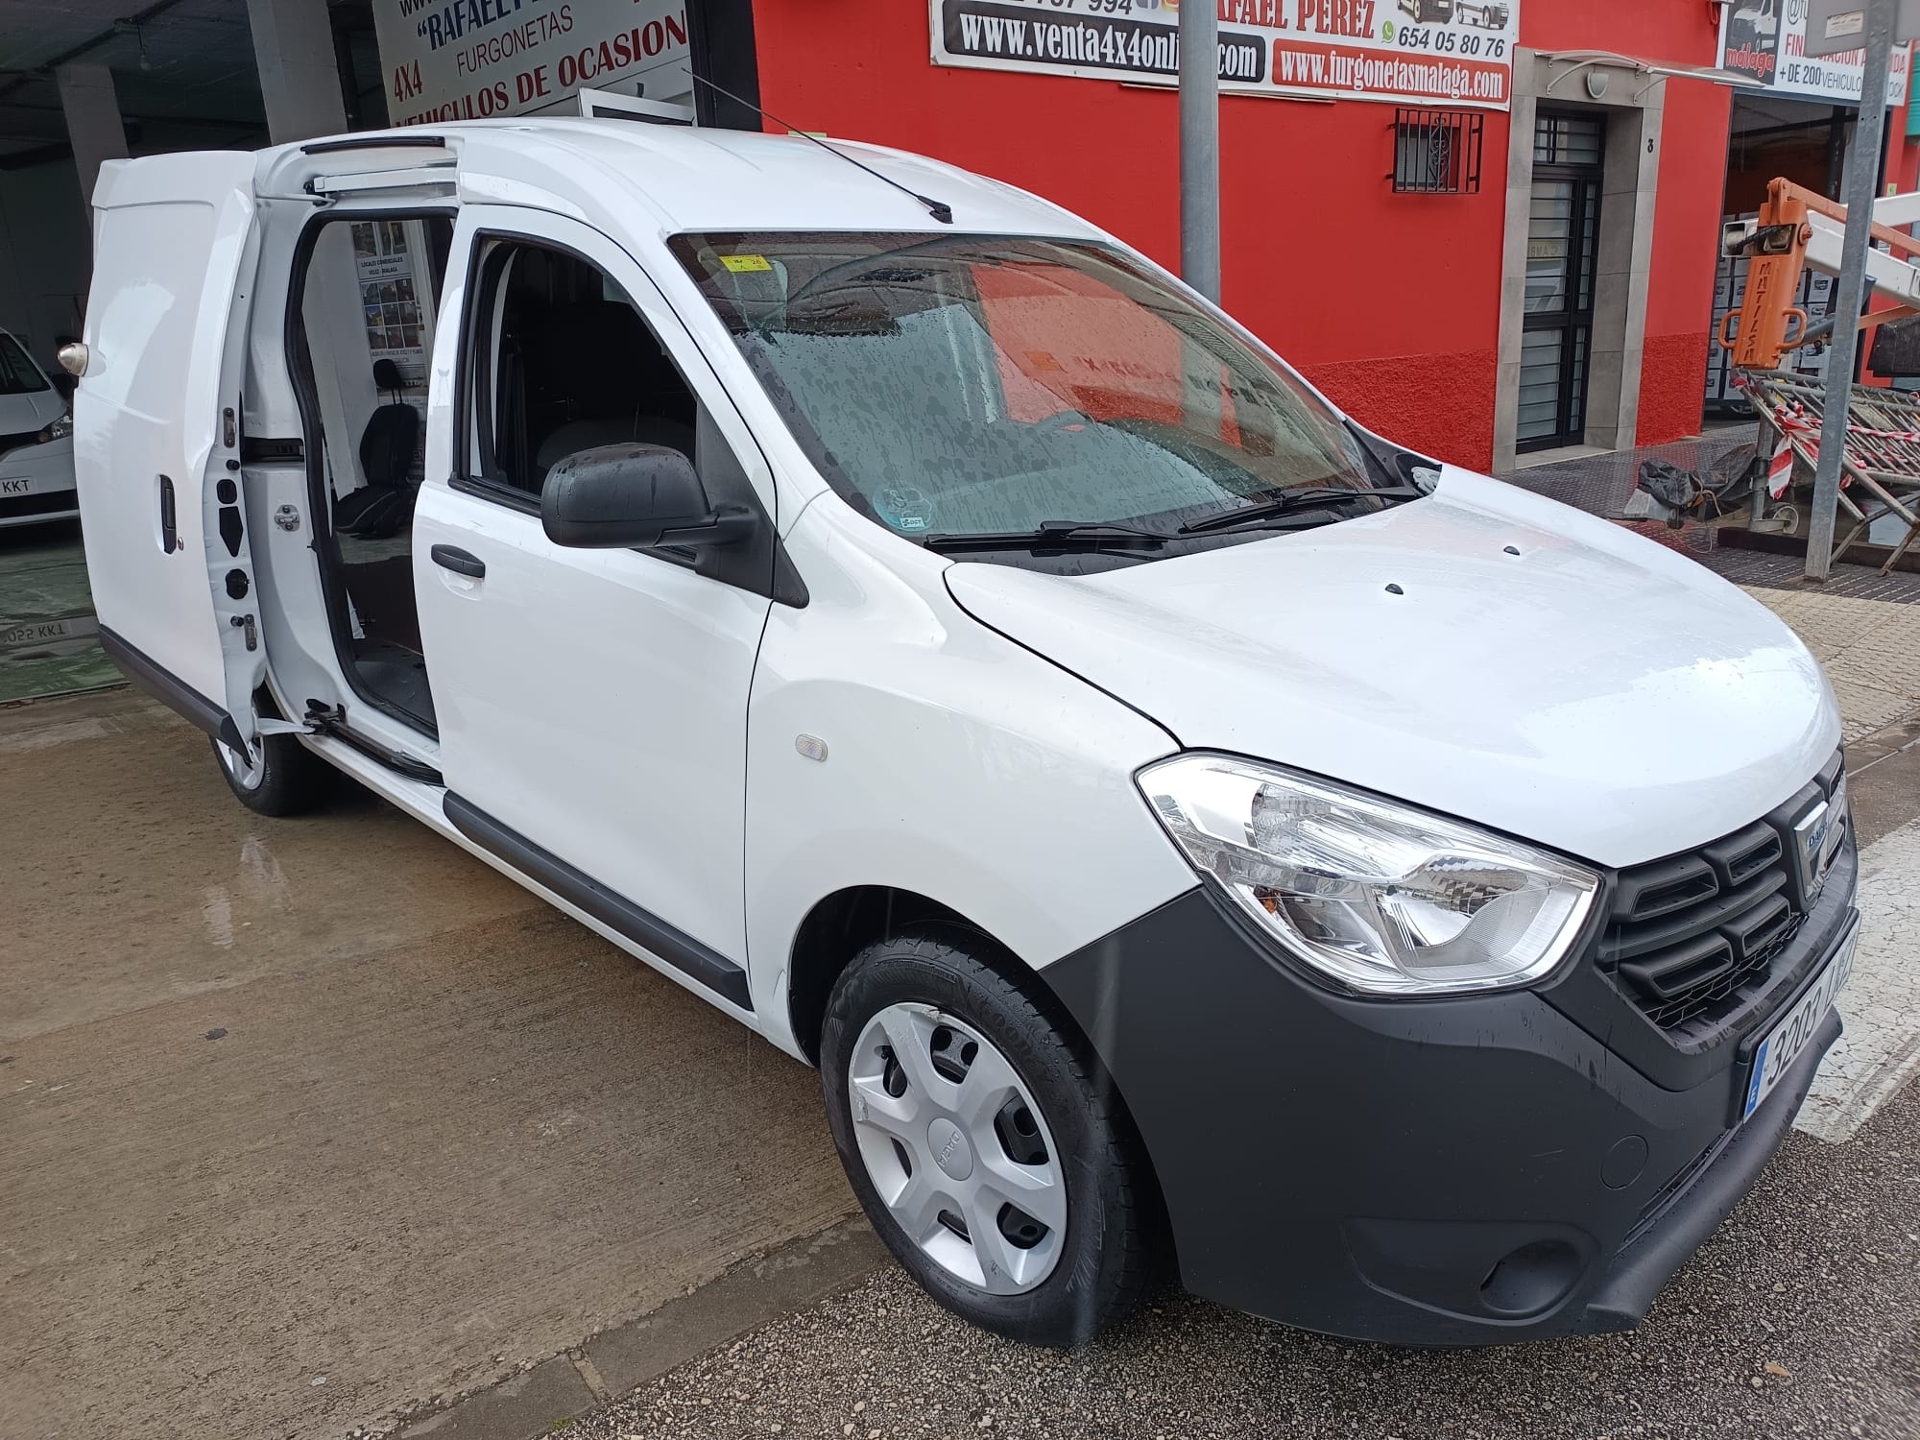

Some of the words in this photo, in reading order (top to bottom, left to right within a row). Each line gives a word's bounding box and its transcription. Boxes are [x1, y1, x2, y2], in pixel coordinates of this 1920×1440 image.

[1217, 0, 1288, 29] FAEL
[456, 5, 573, 77] FURGONETAS
[960, 13, 1257, 78] www.venta4x4onlicom
[1399, 26, 1430, 49] 654
[1434, 31, 1455, 52] 05
[1459, 34, 1481, 55] 80
[1485, 37, 1505, 58] 76
[396, 82, 510, 127] ICULOS
[515, 65, 551, 104] DE
[558, 10, 687, 87] OCASION
[1280, 50, 1503, 99] www.furgonetasmalaga.com
[1788, 63, 1801, 83] DE
[1803, 65, 1821, 85] 200
[1822, 70, 1862, 92] VEHICULO
[1743, 262, 1771, 361] MATILSA
[2, 479, 30, 493] KKT
